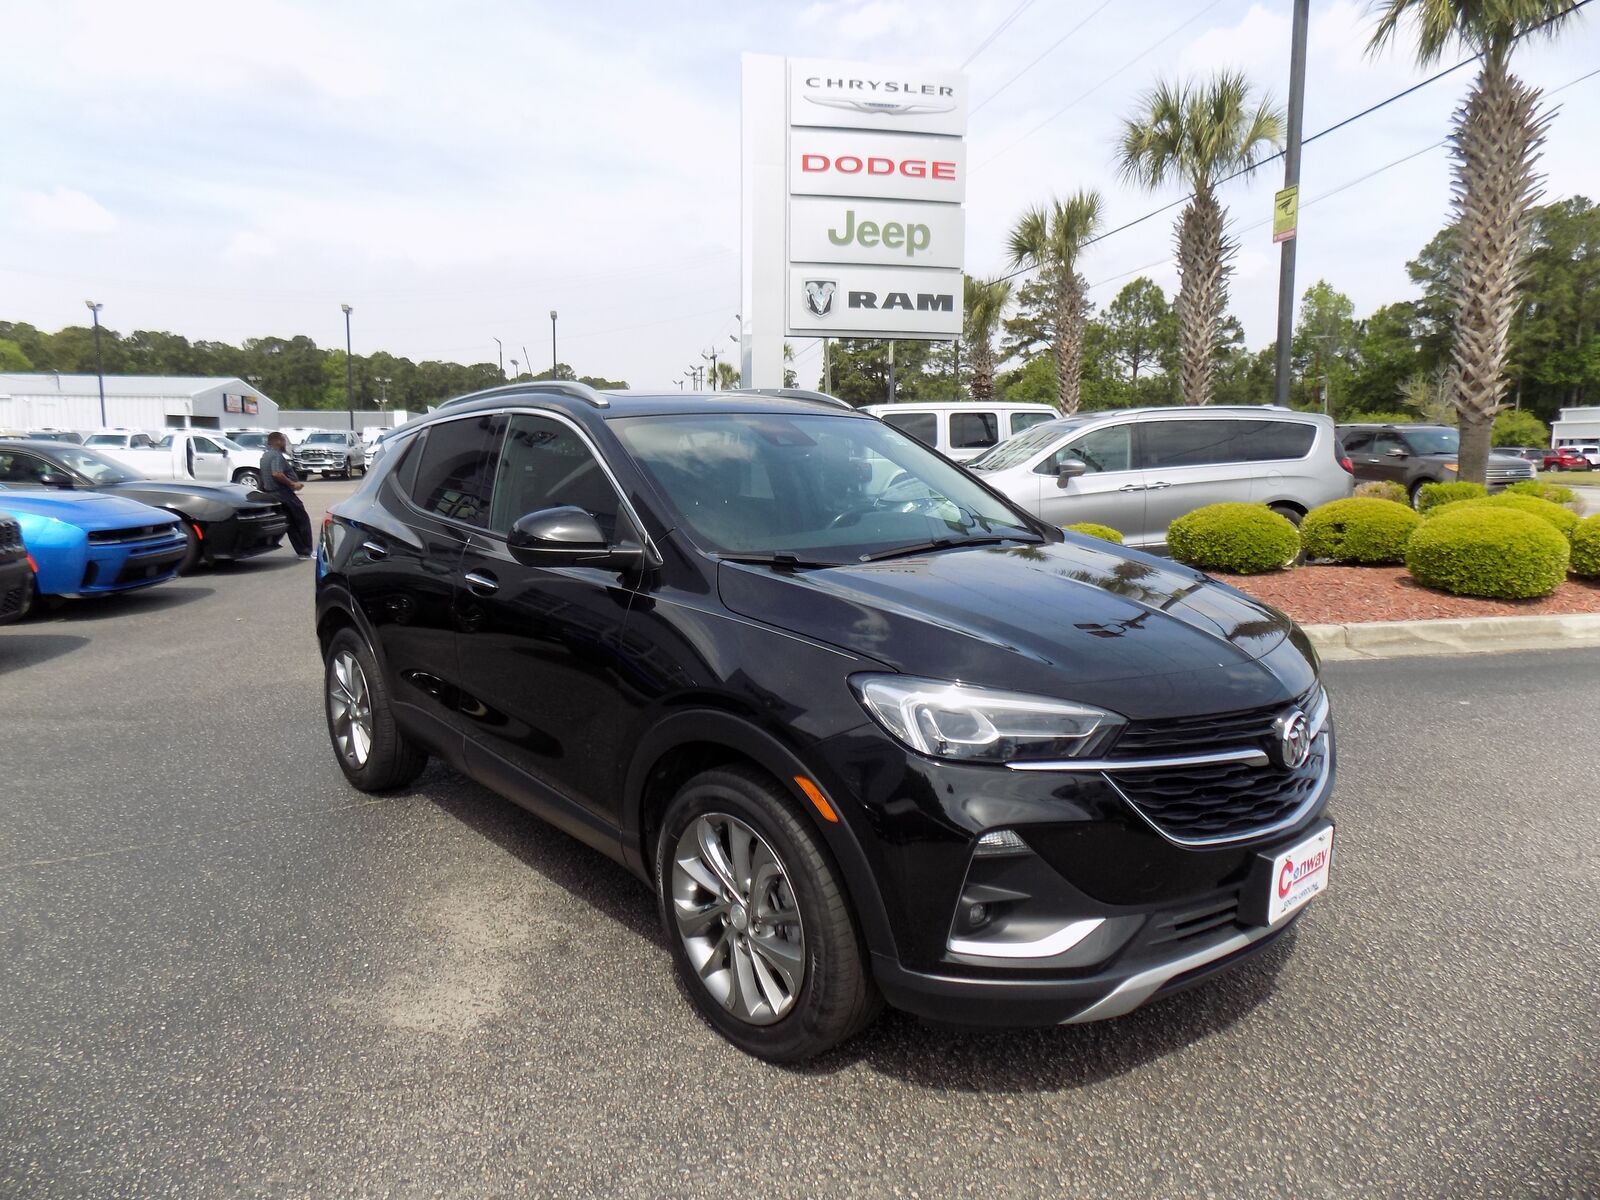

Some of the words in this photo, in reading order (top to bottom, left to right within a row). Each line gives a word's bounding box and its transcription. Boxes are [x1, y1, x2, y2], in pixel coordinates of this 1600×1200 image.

[806, 77, 954, 97] CHRYSLER
[802, 154, 956, 181] DODGE
[828, 210, 931, 257] Jeep
[848, 291, 954, 312] RAM
[1278, 849, 1328, 898] Conway
